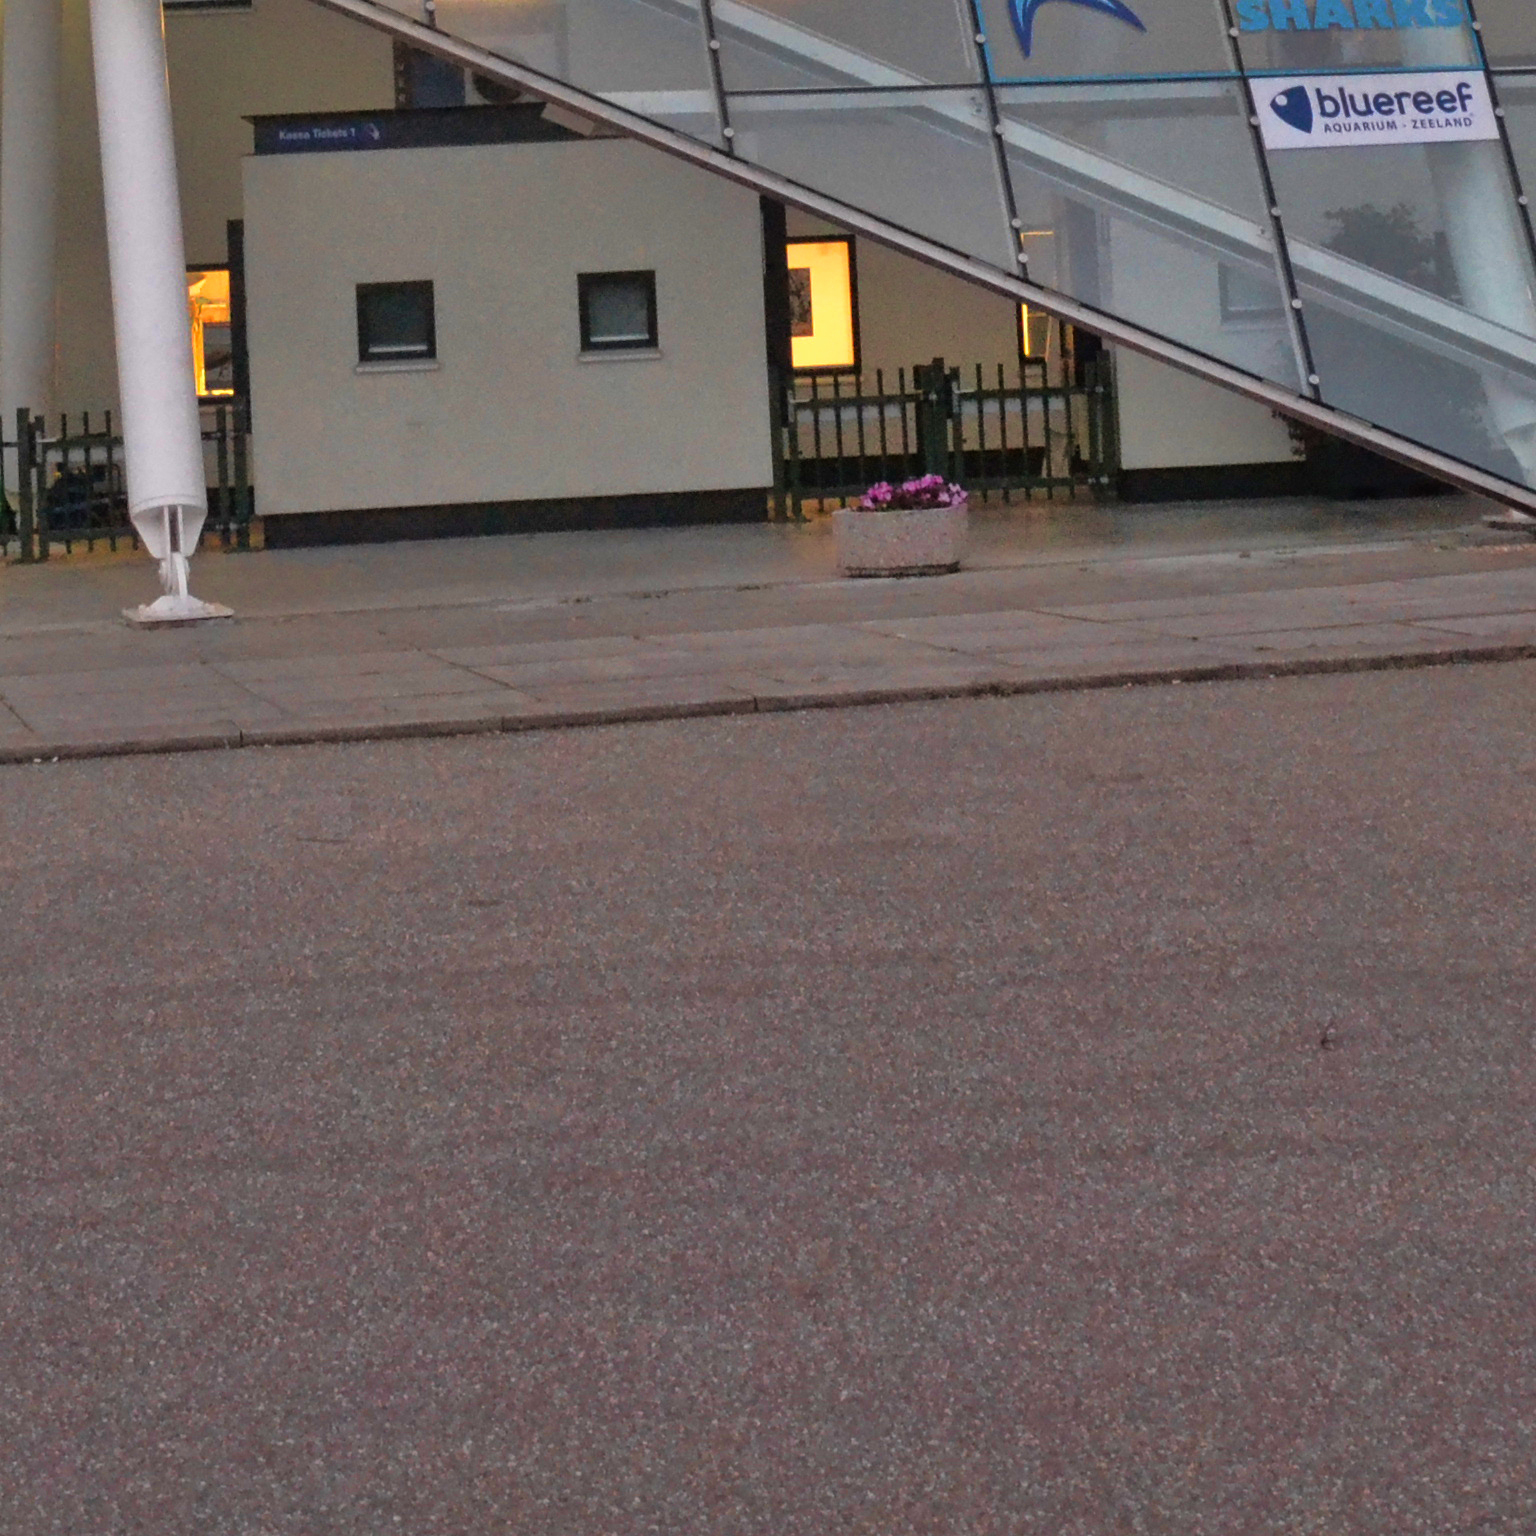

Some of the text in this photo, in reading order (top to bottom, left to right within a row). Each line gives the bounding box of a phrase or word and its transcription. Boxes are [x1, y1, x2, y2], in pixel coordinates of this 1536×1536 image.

[1315, 81, 1474, 118] bluereef
[279, 130, 310, 140] Kassa
[313, 127, 347, 139] Tickets
[1324, 120, 1398, 134] AQUARIUM
[1411, 117, 1473, 130] ZEELAND
